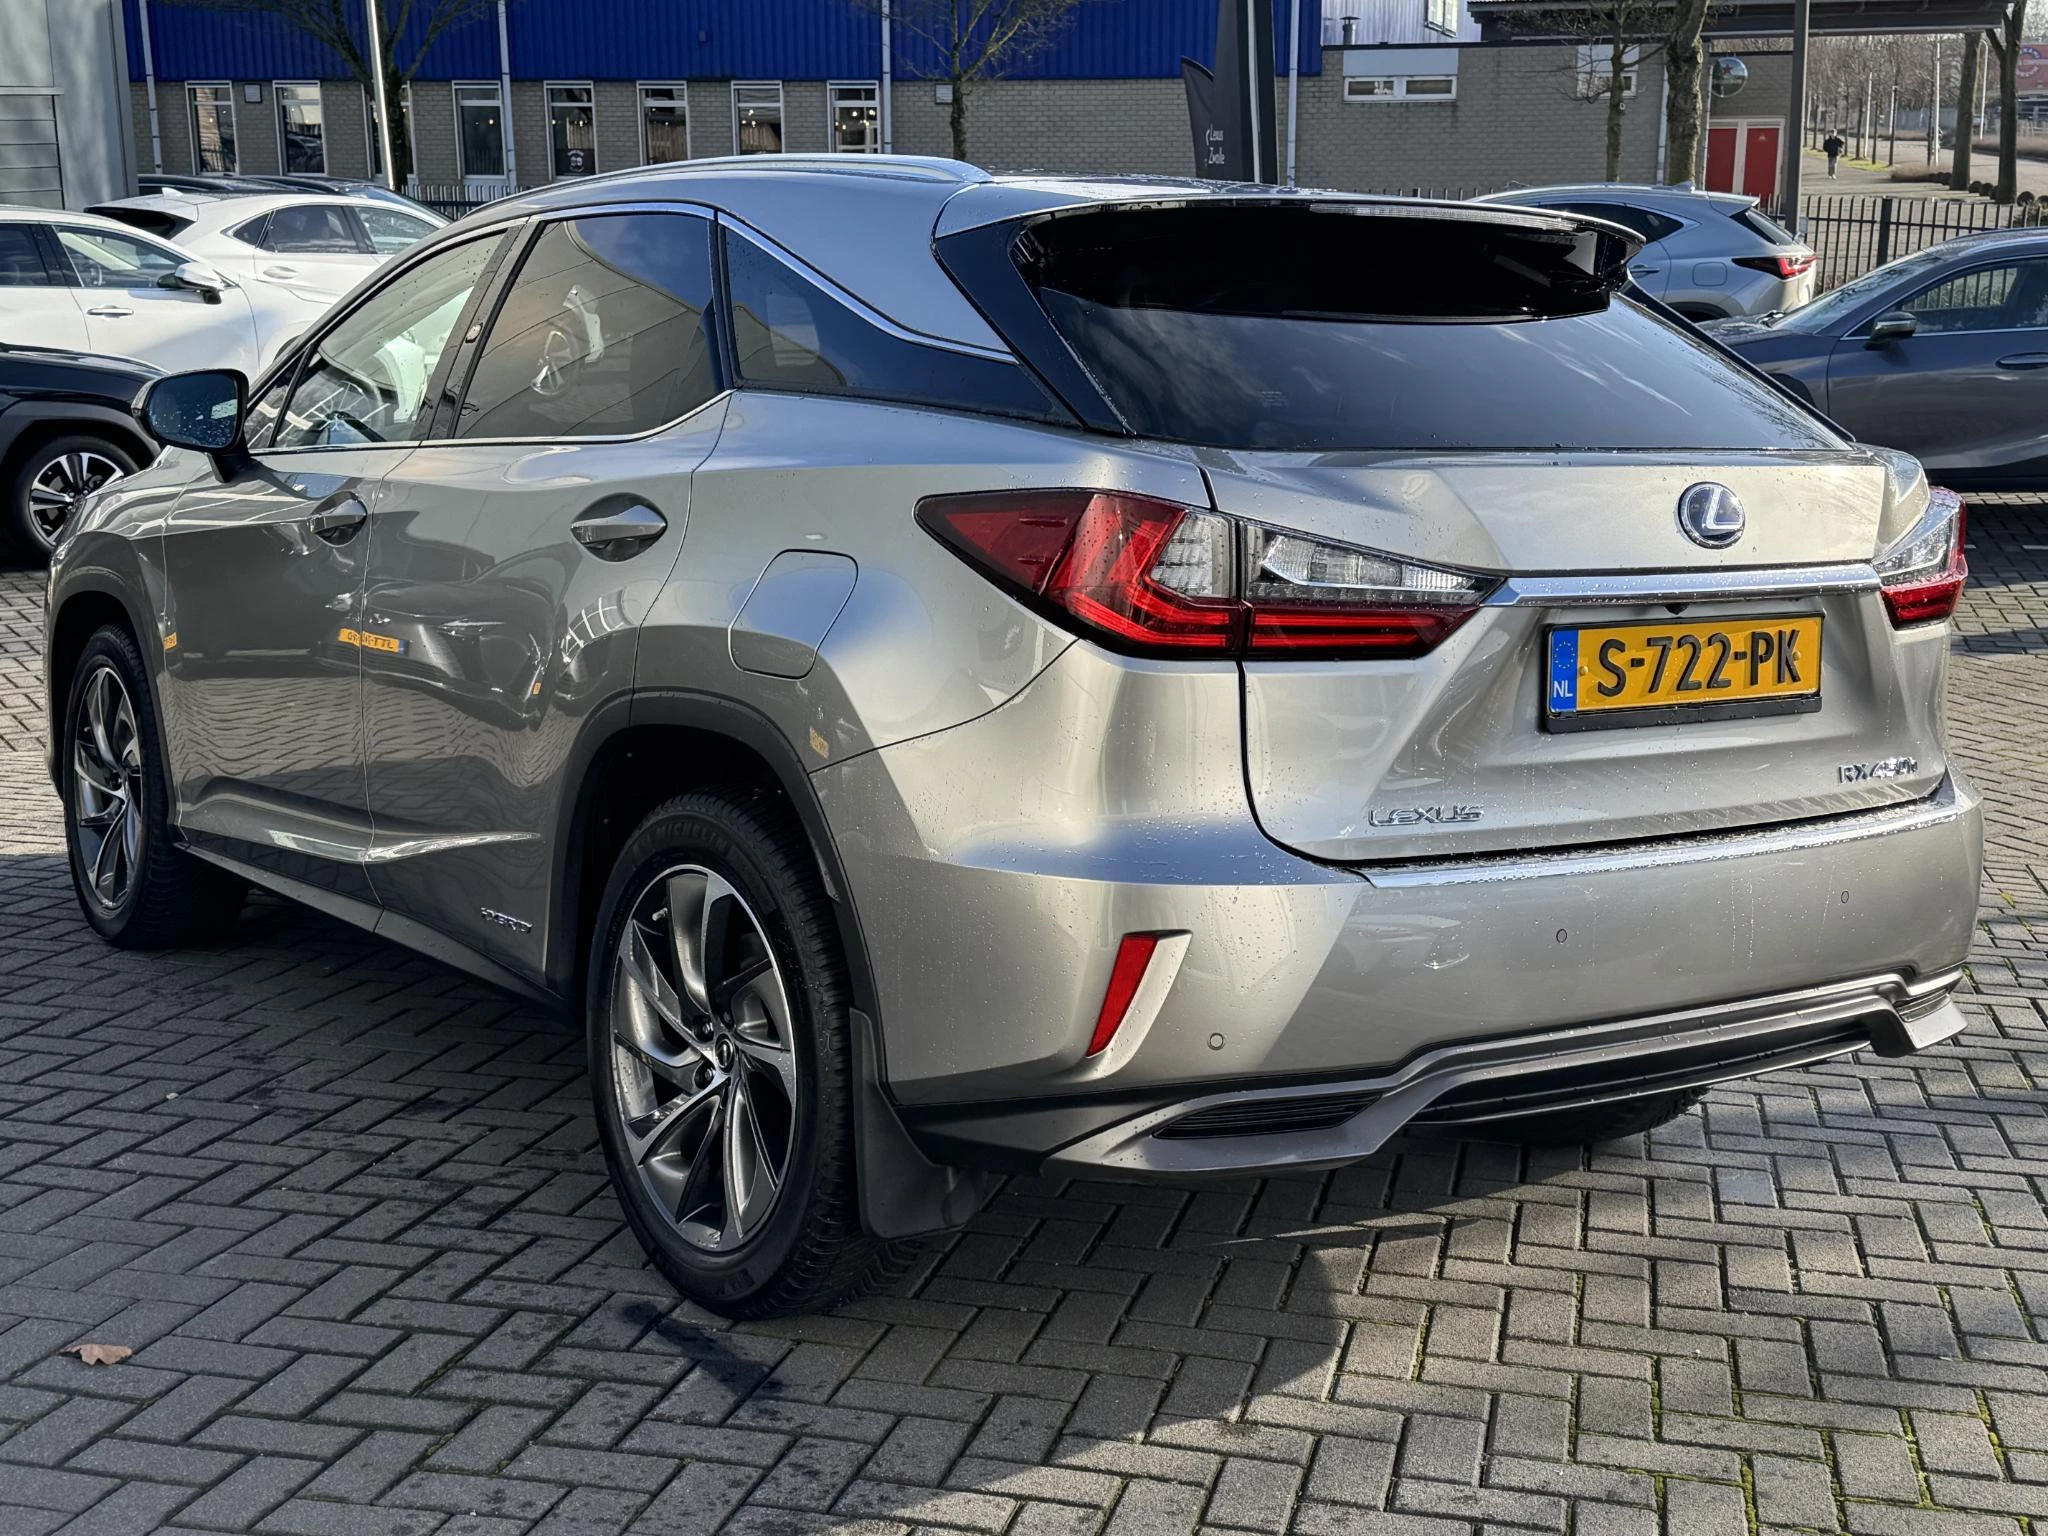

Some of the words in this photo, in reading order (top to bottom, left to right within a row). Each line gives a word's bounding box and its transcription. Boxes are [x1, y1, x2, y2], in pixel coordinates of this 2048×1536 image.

[1597, 629, 1801, 698] S-722-PK
[1552, 680, 1574, 699] NL
[1368, 805, 1485, 827] LEXUS
[654, 820, 729, 854] MICHELIN
